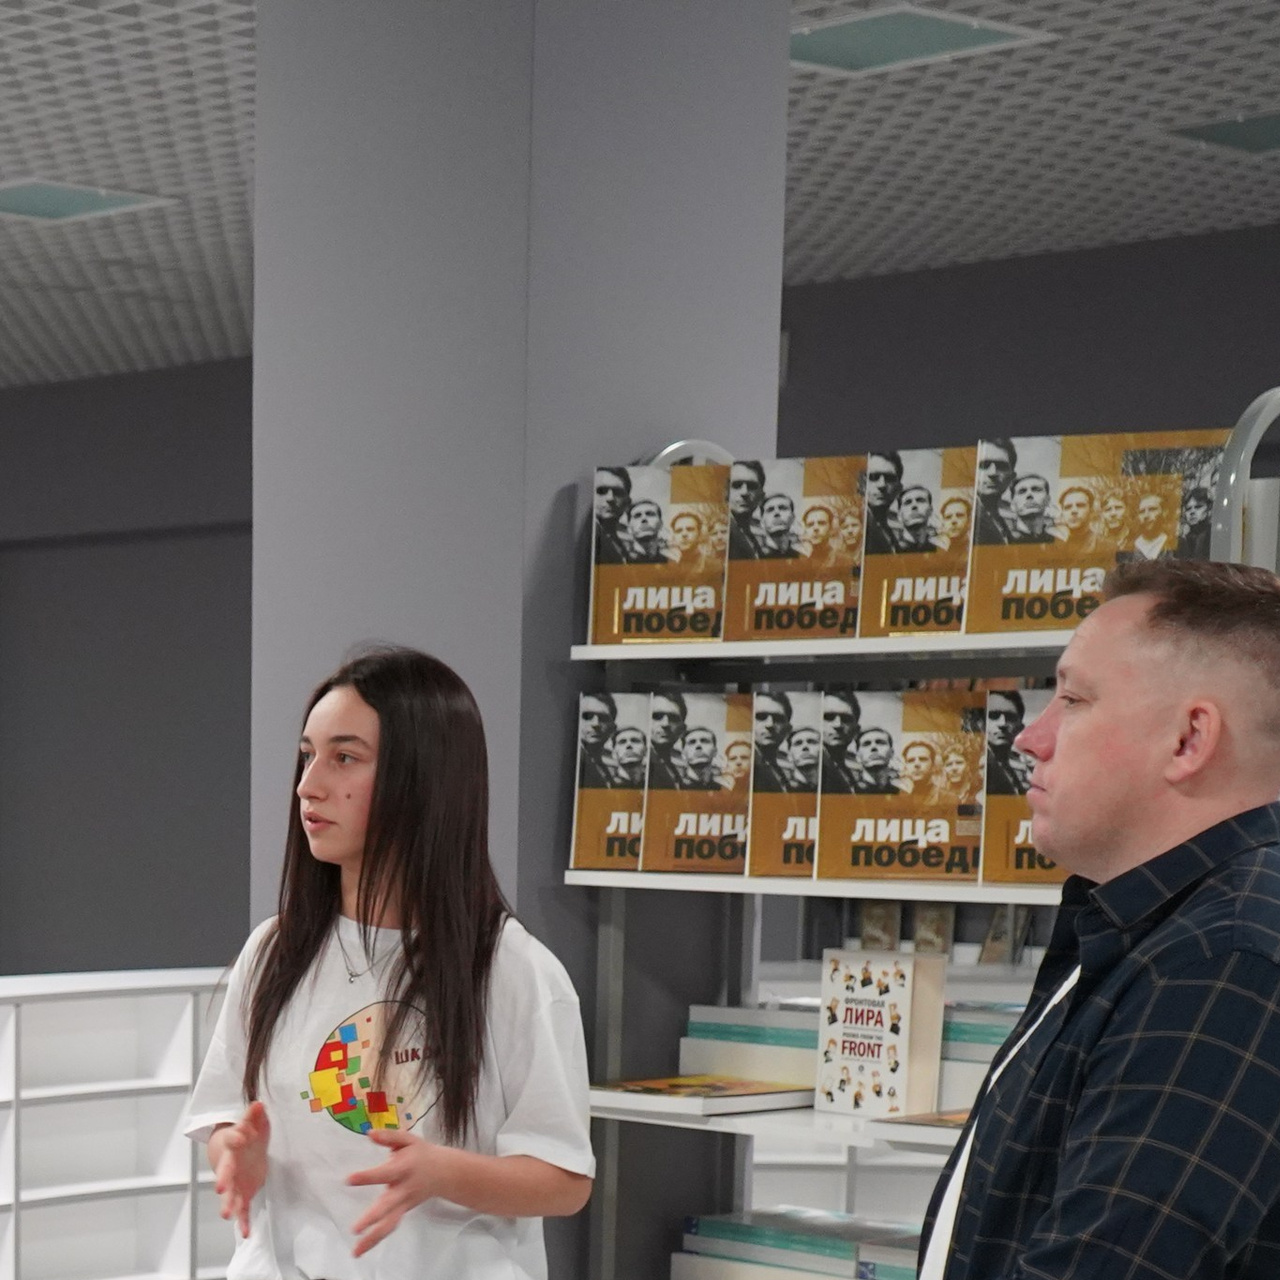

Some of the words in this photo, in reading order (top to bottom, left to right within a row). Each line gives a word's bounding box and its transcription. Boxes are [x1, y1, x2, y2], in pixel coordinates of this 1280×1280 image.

[754, 580, 845, 609] лица
[1002, 567, 1106, 598] лица
[623, 586, 715, 614] лица
[674, 812, 748, 842] лиц
[850, 818, 950, 848] лица
[674, 834, 746, 860] поб
[843, 1007, 884, 1028] ЛИРА
[841, 1039, 883, 1059] FRONT
